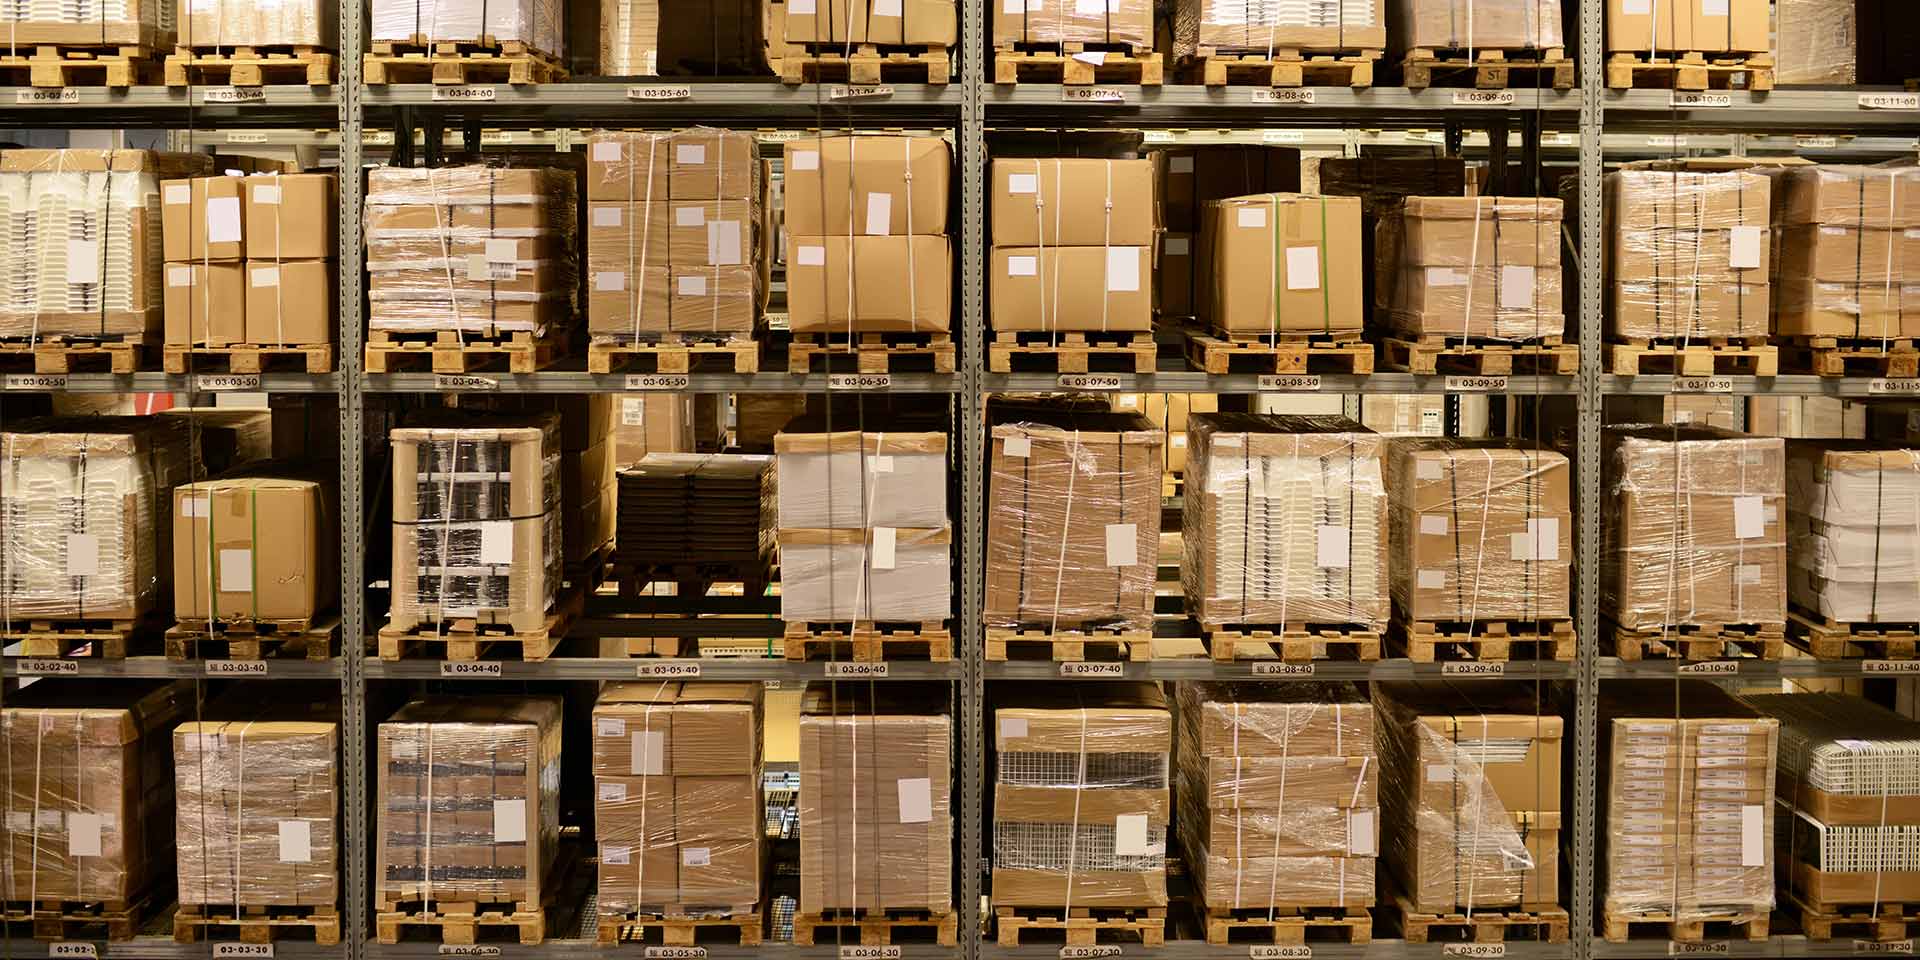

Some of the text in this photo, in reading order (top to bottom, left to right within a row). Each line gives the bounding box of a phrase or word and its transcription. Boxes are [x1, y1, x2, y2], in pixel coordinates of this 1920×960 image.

[1487, 70, 1501, 80] ST
[34, 91, 77, 100] 03-02-60
[221, 91, 264, 99] 03-03-60
[449, 89, 493, 97] 03-04-60
[645, 89, 688, 97] 03-05-60
[1269, 91, 1312, 99] 03-08-60
[1470, 93, 1512, 101] 03-09-60
[1686, 95, 1728, 103] 03-10-60
[1874, 97, 1916, 105] 03-11-60
[23, 378, 65, 386] 03-02-50
[215, 378, 258, 386] 03-03-50
[643, 378, 686, 386] 03-05-50
[1075, 378, 1118, 386] 03-07-50
[1275, 378, 1318, 386] 03-08-50
[1462, 379, 1505, 387] 03-09-50
[1688, 379, 1730, 387] 03-10-50
[34, 663, 76, 671] 03-02-40
[222, 664, 264, 672] 03-03-40
[456, 665, 499, 673] 03-04-40
[654, 666, 698, 674] 03-05-40
[842, 665, 885, 673] 03-06-40
[1077, 665, 1120, 673] 03-07-40
[1269, 666, 1312, 674] 03-08-40
[1459, 665, 1501, 673] 03-09-40
[662, 949, 705, 957] 03-05-30
[856, 949, 898, 957] 03-06-30
[1460, 946, 1503, 954] 03-09-30
